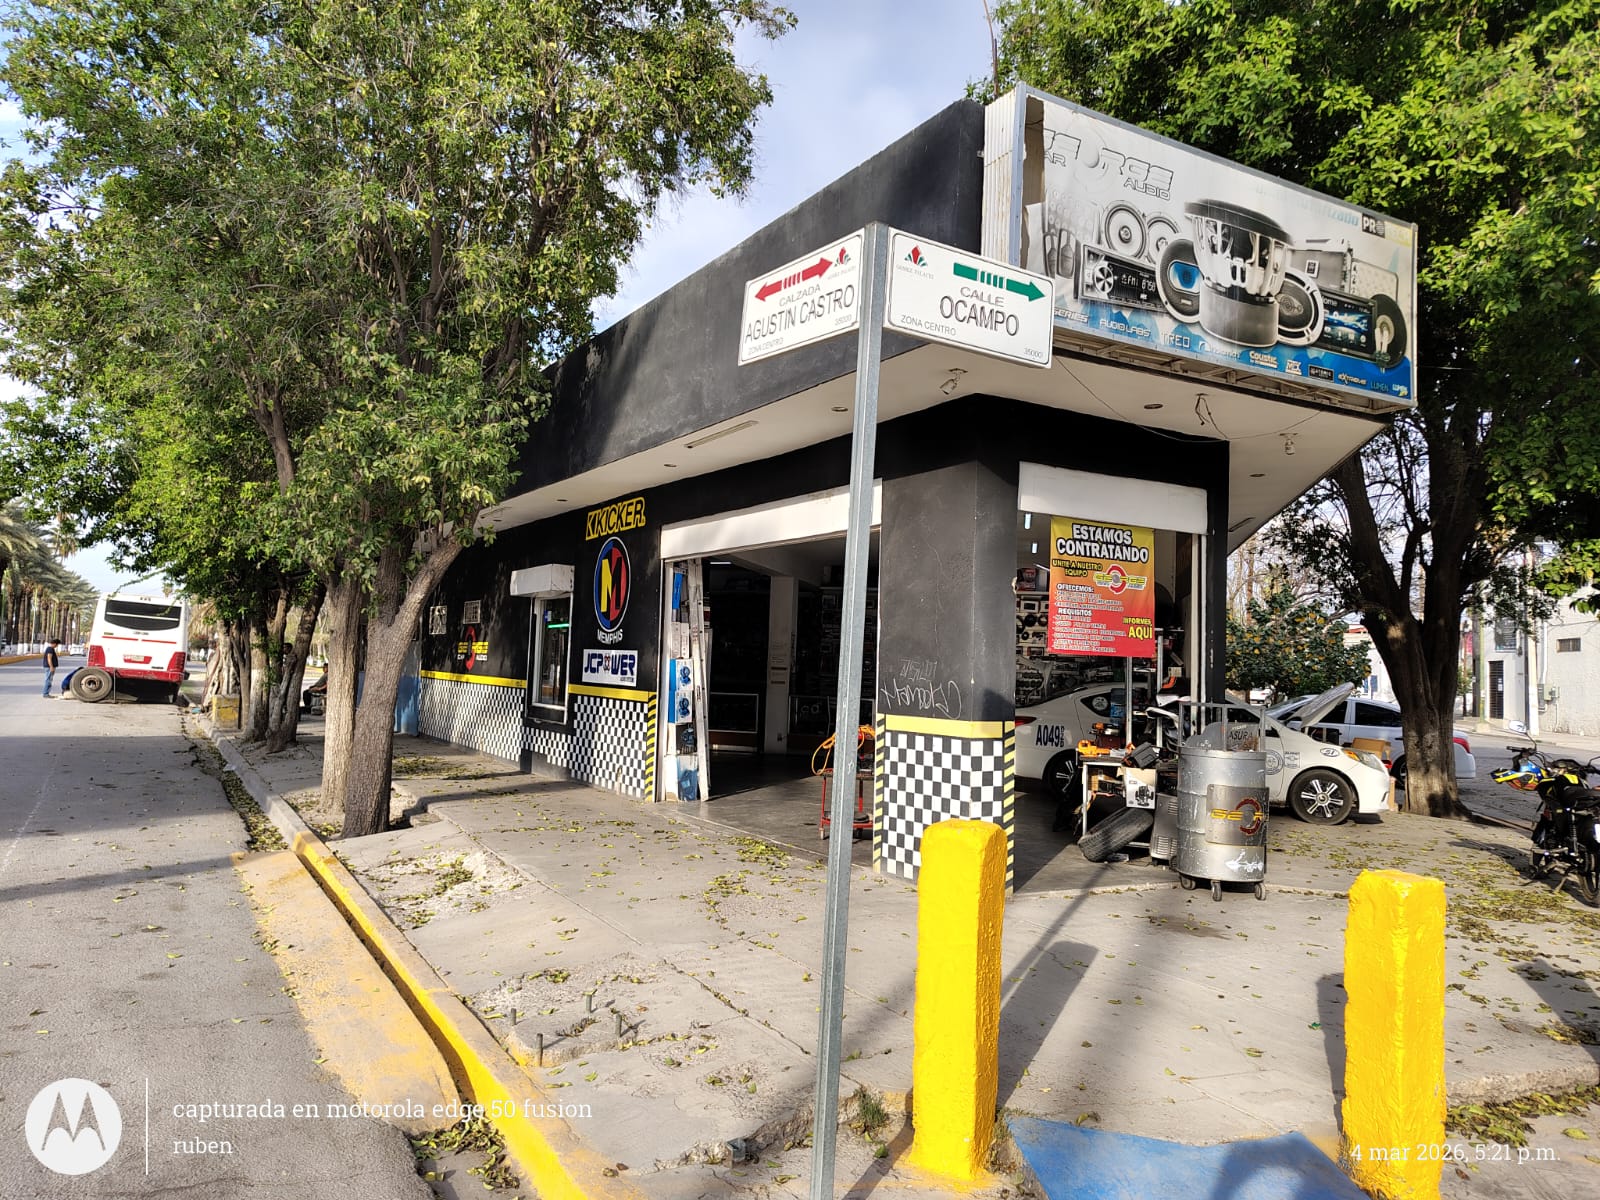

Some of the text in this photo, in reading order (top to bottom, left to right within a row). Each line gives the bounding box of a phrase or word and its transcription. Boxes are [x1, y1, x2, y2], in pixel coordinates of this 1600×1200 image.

[1123, 177, 1171, 201] AUDIO
[779, 284, 820, 307] CALZADA
[960, 286, 1004, 307] CALLE
[744, 284, 855, 344] AGUSTIN CASTRO
[901, 314, 956, 336] ZONA CENTRO
[940, 295, 1019, 336] OCAMPO
[1073, 524, 1132, 544] ESTAMOS
[1056, 538, 1149, 563] CONTRATANDO
[1065, 568, 1088, 577] EQUIPO
[1077, 561, 1103, 571] NUESTRO
[597, 629, 623, 644] MEMPHIS
[1035, 724, 1060, 747] A049
